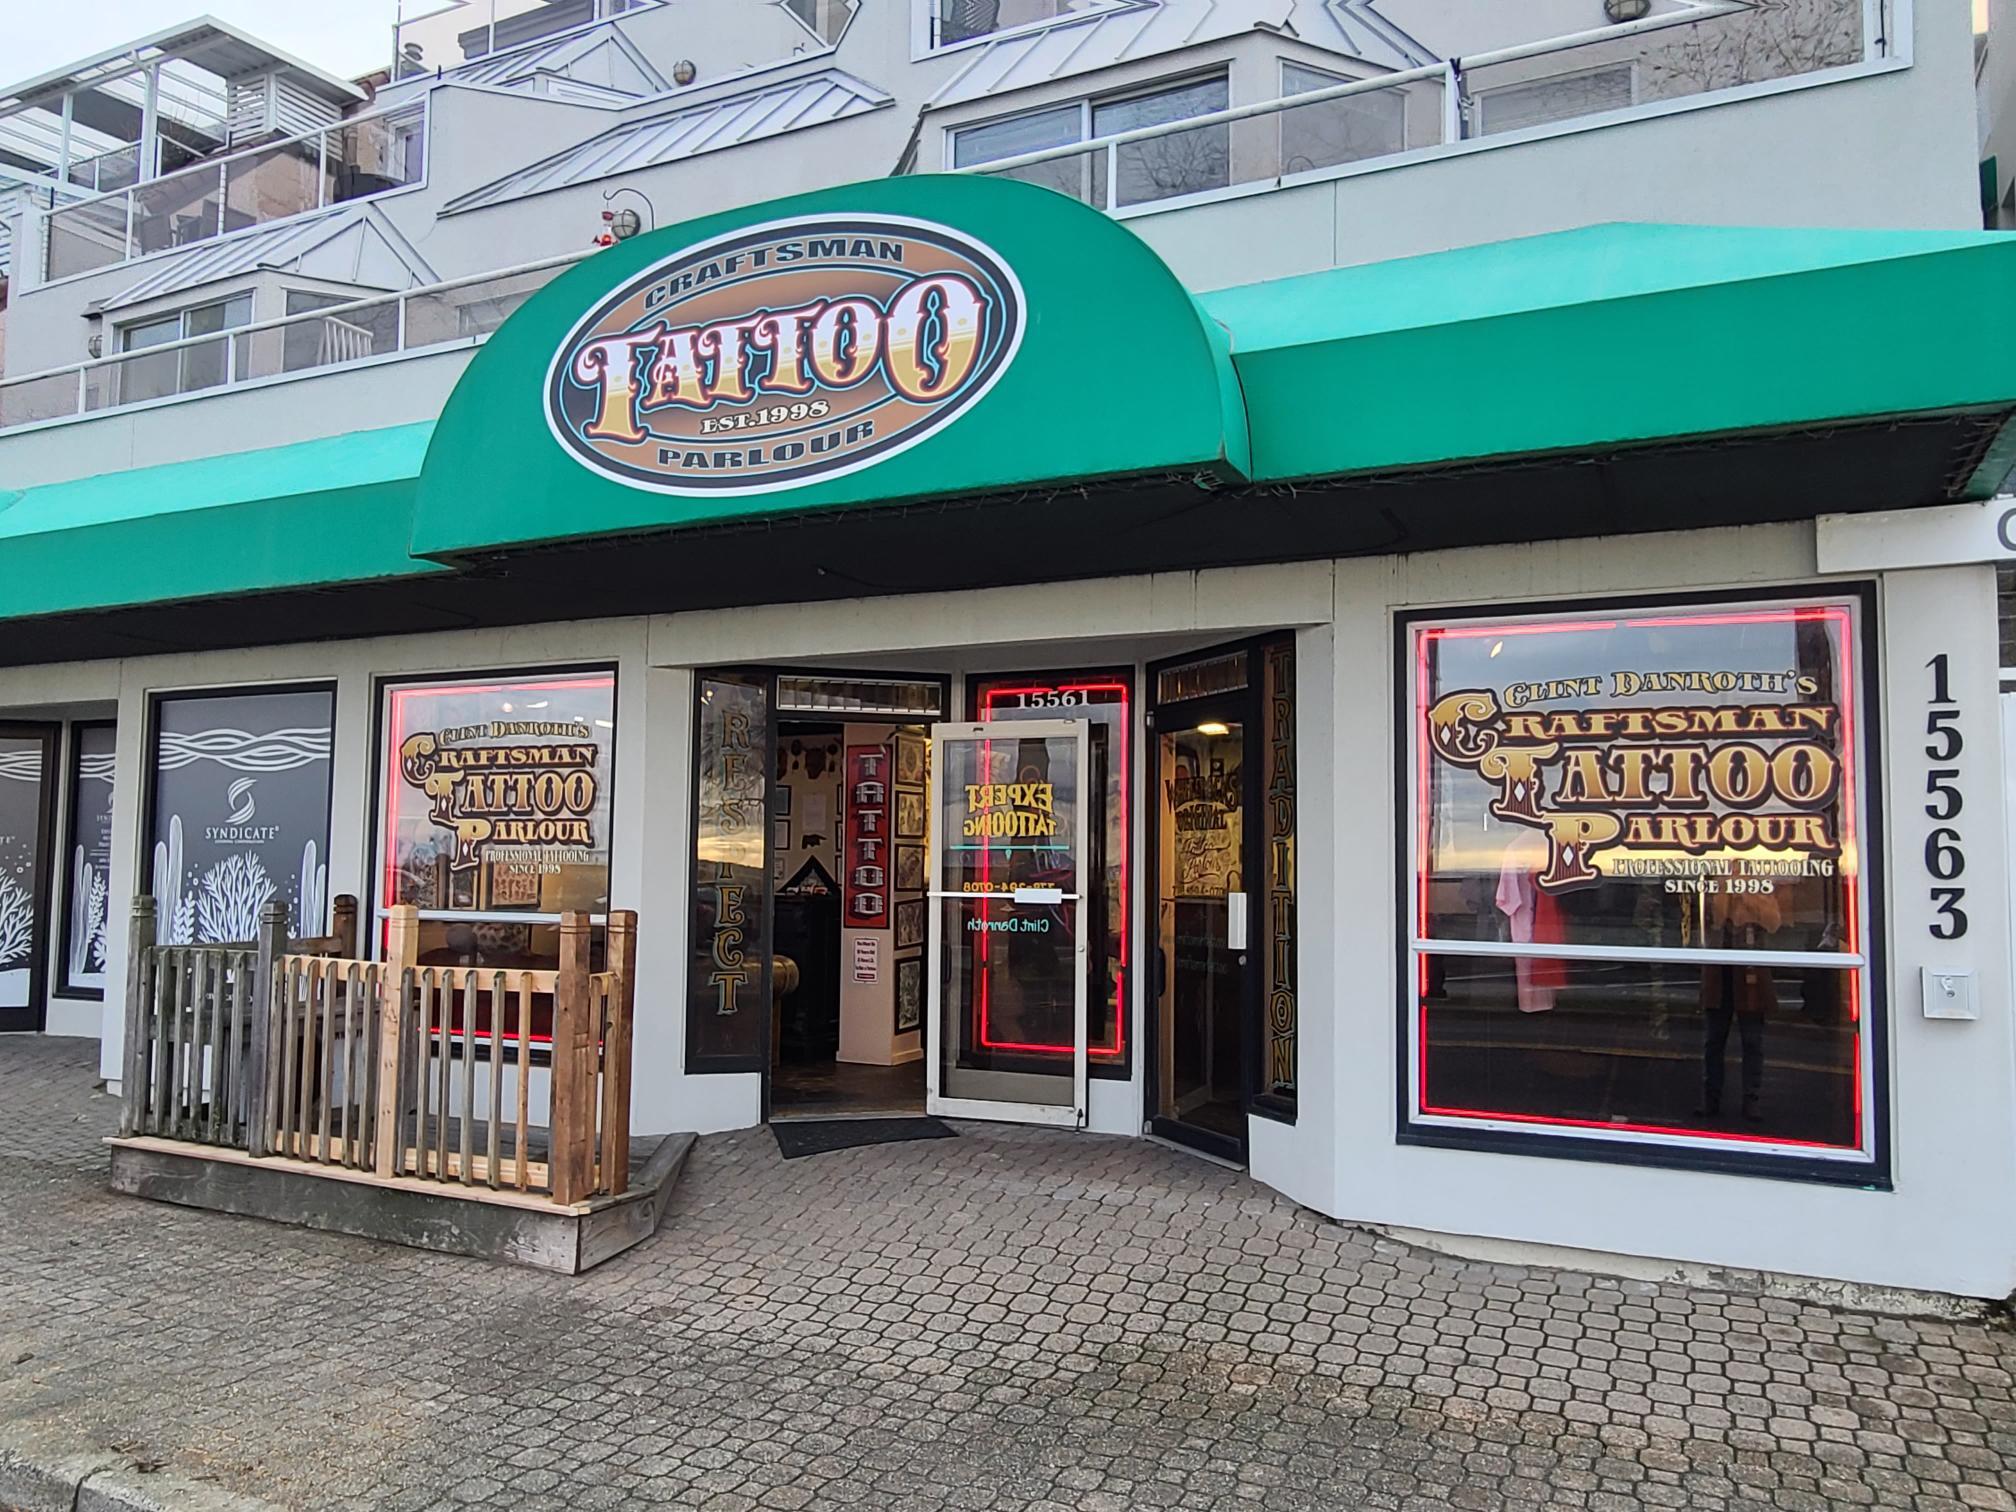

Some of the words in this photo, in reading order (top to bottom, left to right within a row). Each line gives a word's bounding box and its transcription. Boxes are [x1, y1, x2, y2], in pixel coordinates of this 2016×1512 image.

[644, 238, 904, 310] CRAFTSMAN
[574, 276, 986, 442] TATTOO
[658, 419, 874, 469] PARLOUR
[700, 401, 831, 434] EST.1998
[1016, 689, 1090, 710] 15561
[1502, 674, 1602, 708] CLINT
[1612, 670, 1819, 698] DANROTH'S
[440, 723, 488, 746] CLINT
[489, 720, 590, 739] DANROTH'S
[1428, 688, 1836, 768] CRAFTSMAN
[400, 732, 597, 785] CRAFTSMAN
[1481, 741, 1842, 820] TATTOO
[424, 769, 596, 823] TATTOO
[1924, 653, 1968, 940] 15563
[204, 826, 276, 840] SYNDICATE
[450, 818, 594, 871] PARLOUR
[485, 849, 542, 863] PROFESSIONAL
[854, 754, 885, 915] TATTOO
[1536, 812, 1840, 896] PARLOUR
[509, 863, 536, 874] SINCE
[538, 863, 562, 874] 1998
[1269, 646, 1294, 1090] TRADITION
[1612, 858, 1734, 878] PROFESSIONAL
[1737, 858, 1834, 879] TATTOOING
[1665, 879, 1721, 895] SINCE
[1724, 878, 1775, 895] 1998
